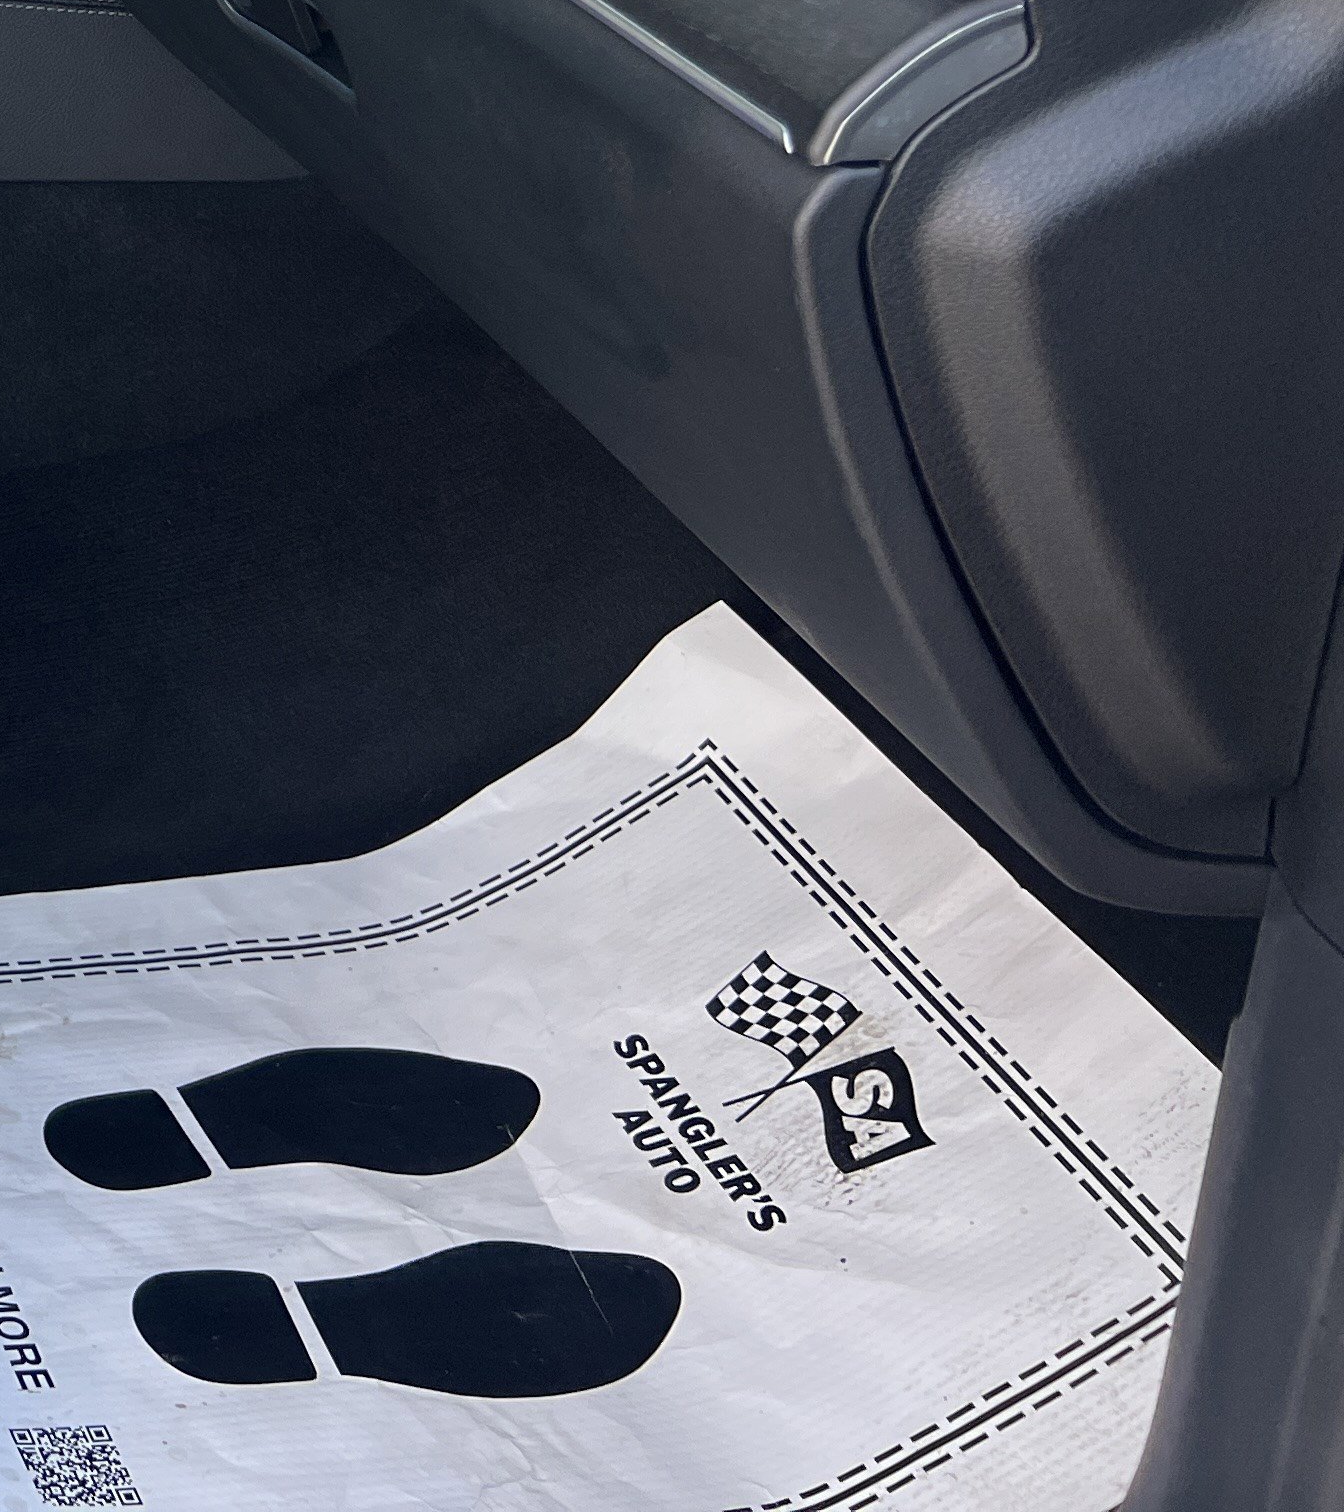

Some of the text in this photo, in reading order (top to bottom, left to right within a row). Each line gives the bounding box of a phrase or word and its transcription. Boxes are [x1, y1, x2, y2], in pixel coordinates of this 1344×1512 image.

[612, 1110, 701, 1193] AUTO
[613, 1034, 787, 1232] SPANGLER'S
[830, 1068, 910, 1162] SA
